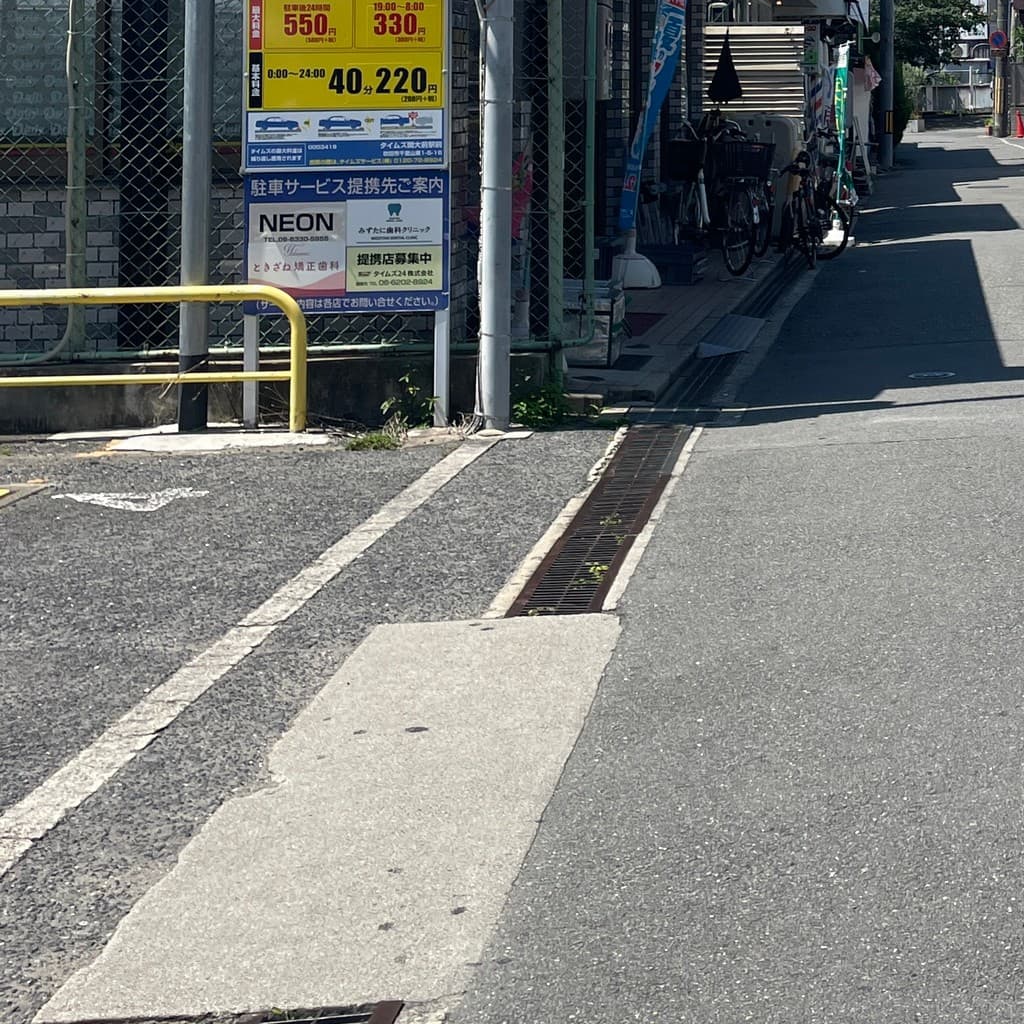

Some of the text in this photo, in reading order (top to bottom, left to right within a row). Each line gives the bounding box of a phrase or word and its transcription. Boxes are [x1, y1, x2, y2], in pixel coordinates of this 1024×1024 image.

[250, 176, 444, 197] 駐車サービス提携先ご案内
[259, 213, 334, 233] NEON
[358, 226, 431, 234] みずたに歯科クリニック
[357, 252, 432, 266] 提携店募集中
